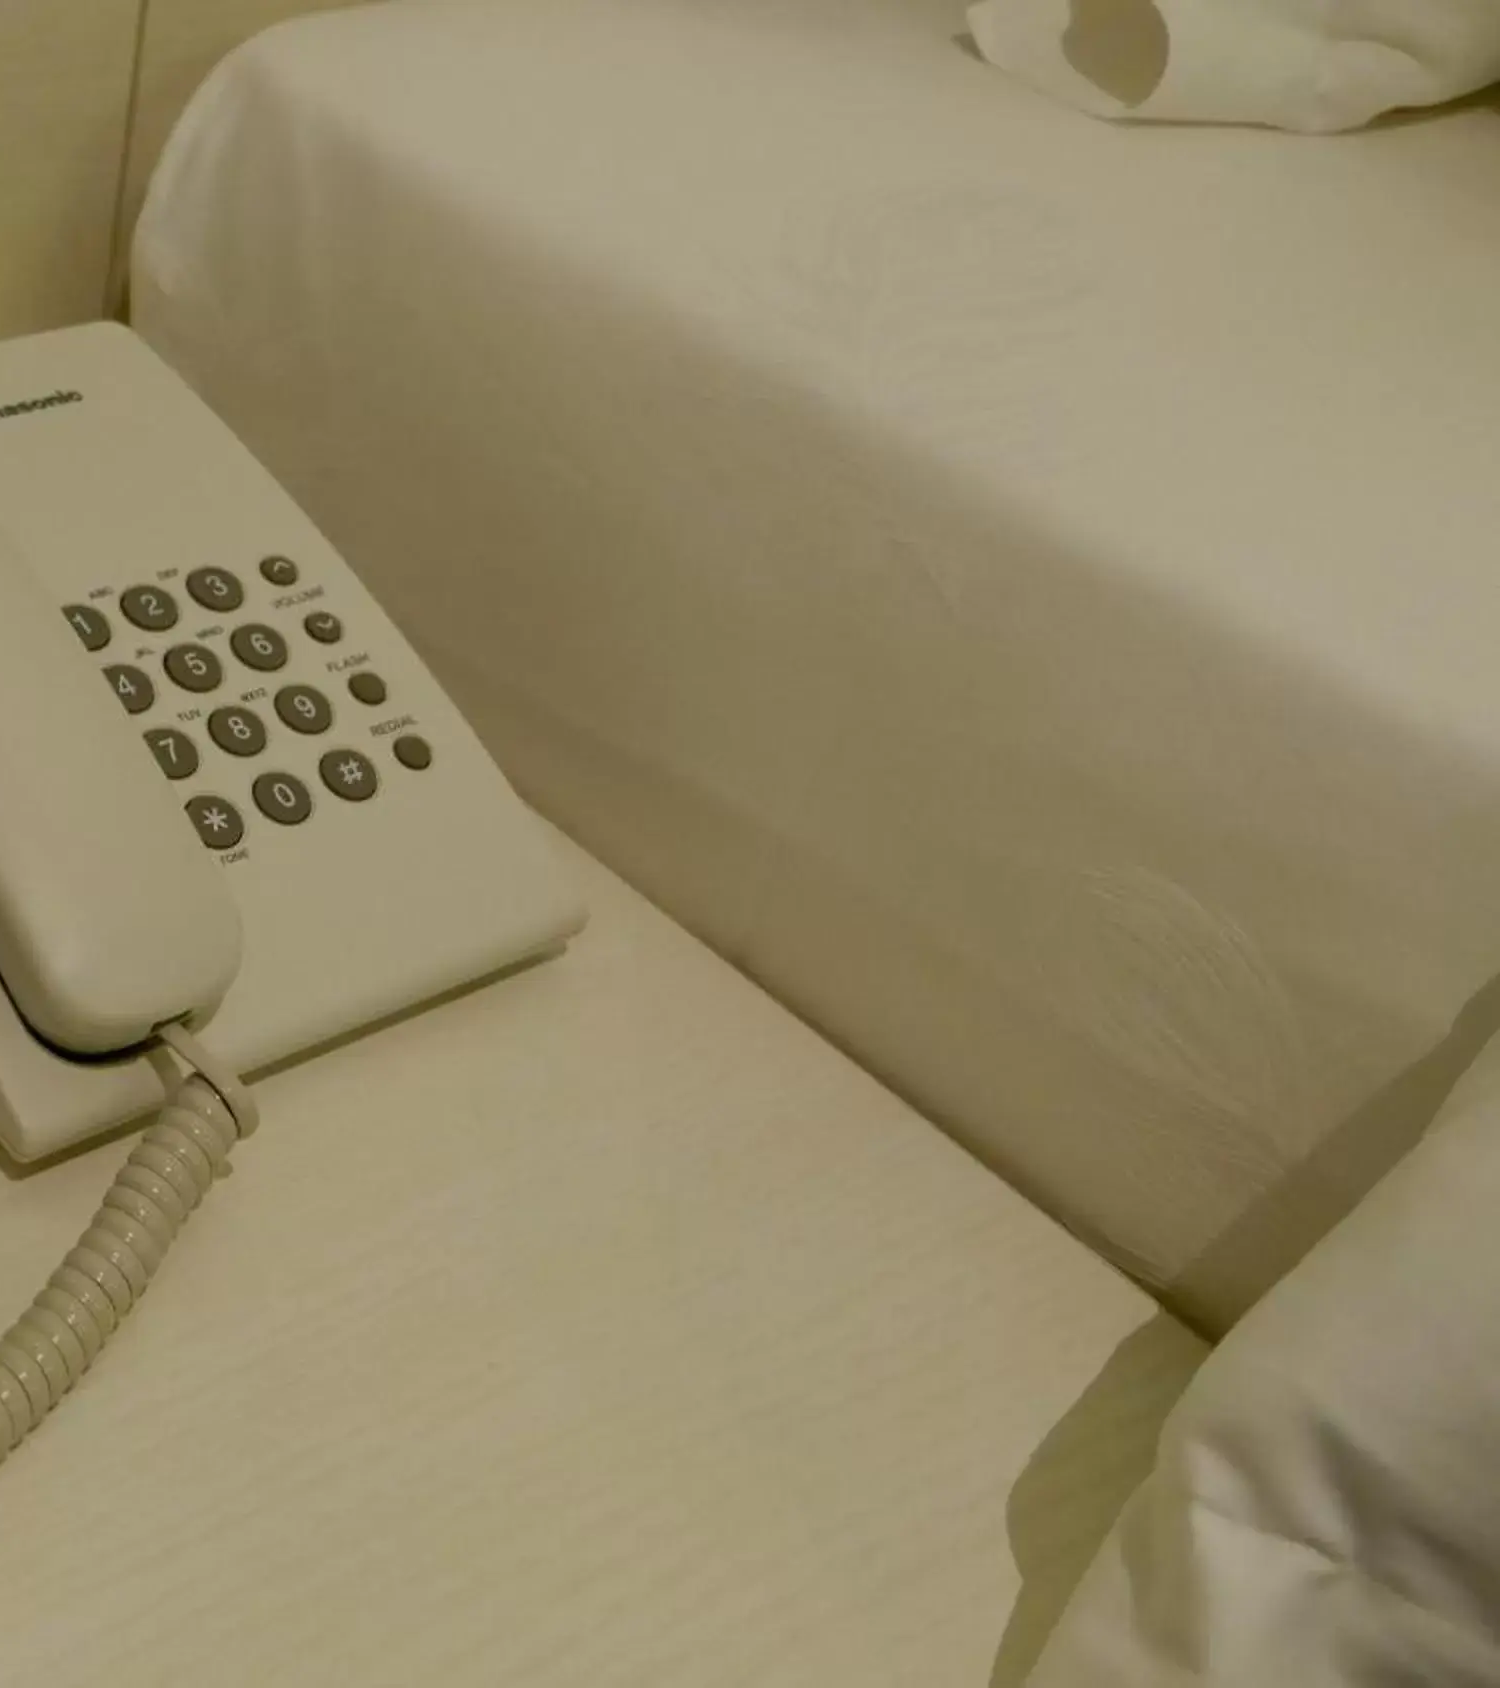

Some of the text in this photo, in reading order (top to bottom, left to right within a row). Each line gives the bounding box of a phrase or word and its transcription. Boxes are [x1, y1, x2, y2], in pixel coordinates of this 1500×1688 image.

[205, 575, 229, 596] 3
[270, 584, 325, 609] VOLUME
[140, 594, 164, 616] 2
[72, 612, 92, 635] 1
[250, 633, 273, 655] 6
[184, 652, 207, 676] 5
[326, 651, 370, 672] FLASH
[118, 673, 136, 697] 4
[177, 708, 202, 722] TUV
[293, 694, 316, 718] 9
[228, 716, 251, 740] 8
[369, 714, 419, 737] REDIAL
[158, 737, 177, 764] 7
[273, 783, 296, 808] 0
[220, 848, 250, 867] TONE
